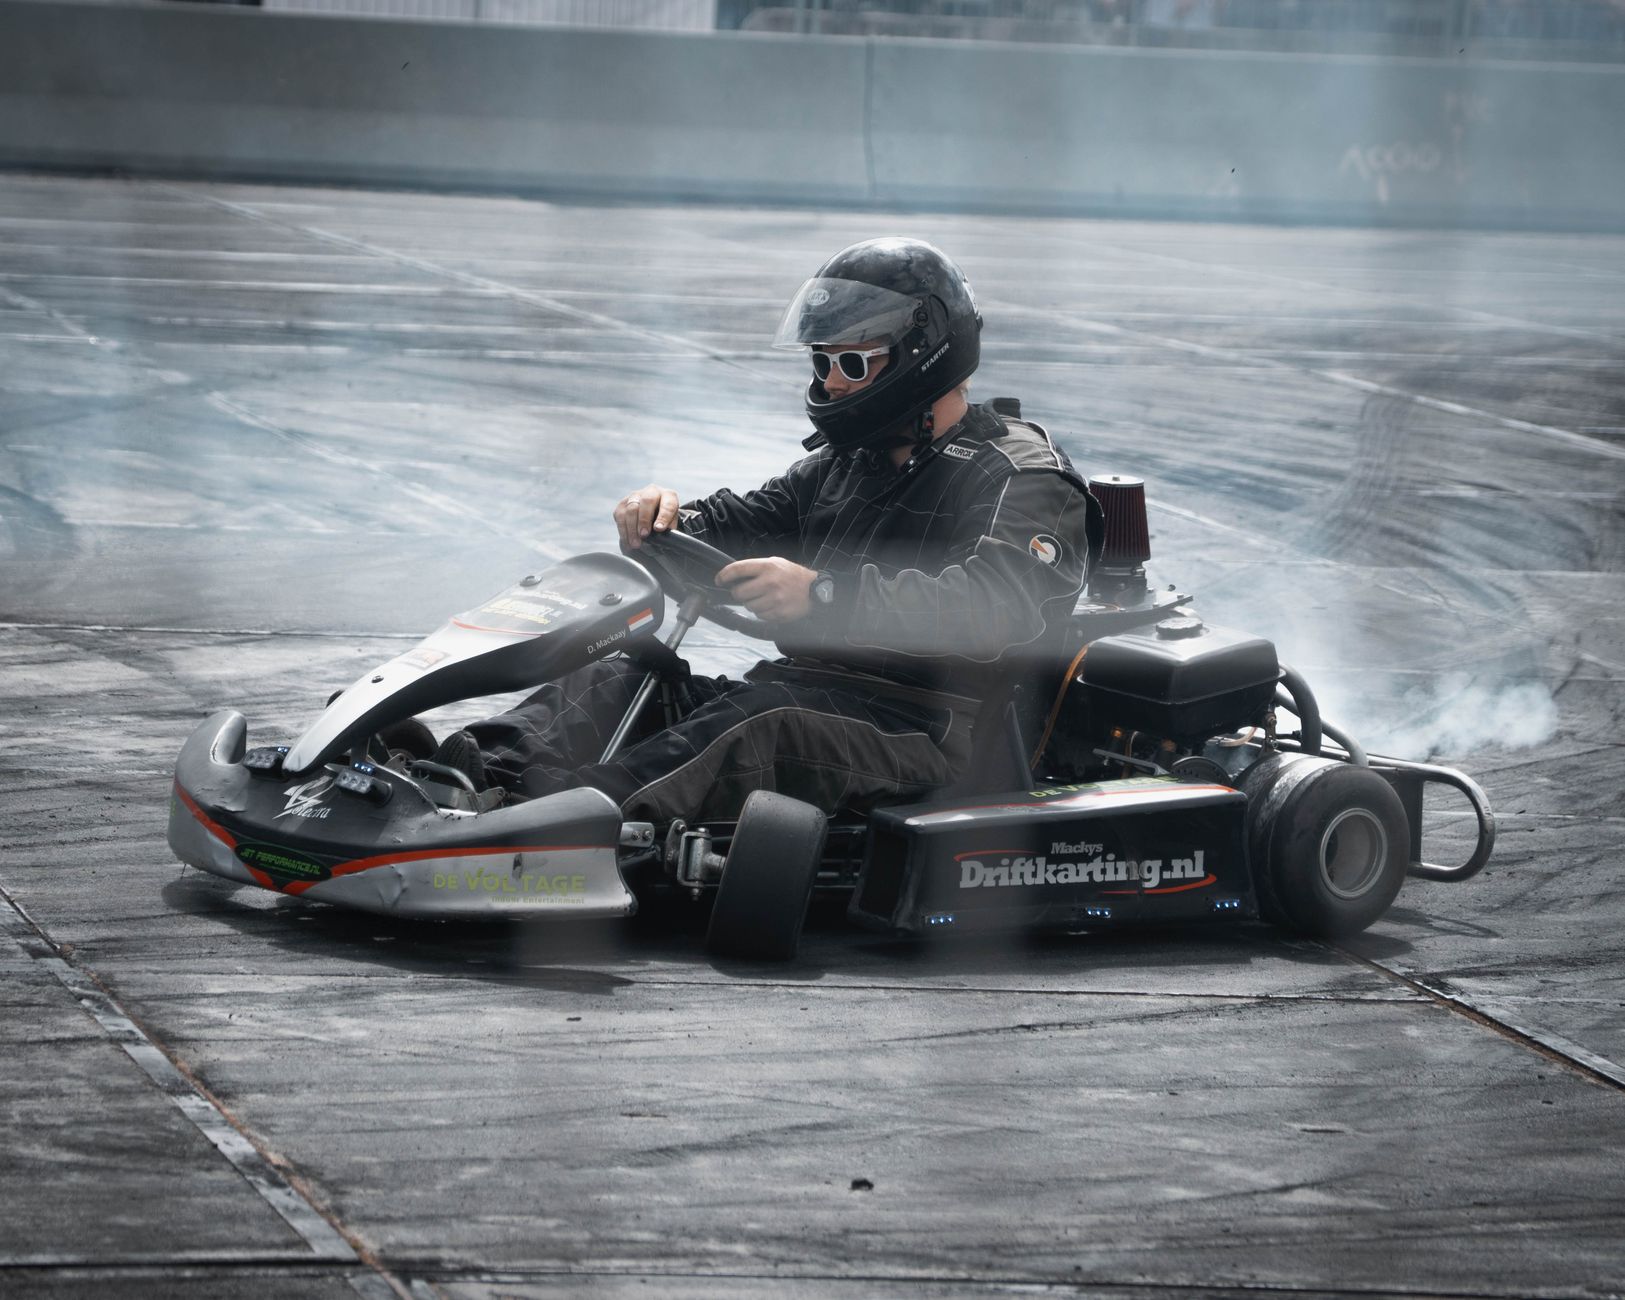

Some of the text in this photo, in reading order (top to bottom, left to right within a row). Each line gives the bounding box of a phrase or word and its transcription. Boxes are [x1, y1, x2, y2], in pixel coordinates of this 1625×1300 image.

[921, 342, 950, 373] STARTER
[587, 629, 626, 655] D. Mackaay
[1051, 841, 1103, 855] Mackys
[433, 867, 586, 895] DE VOLTAGE
[959, 851, 1204, 888] Driftkarting.nl
